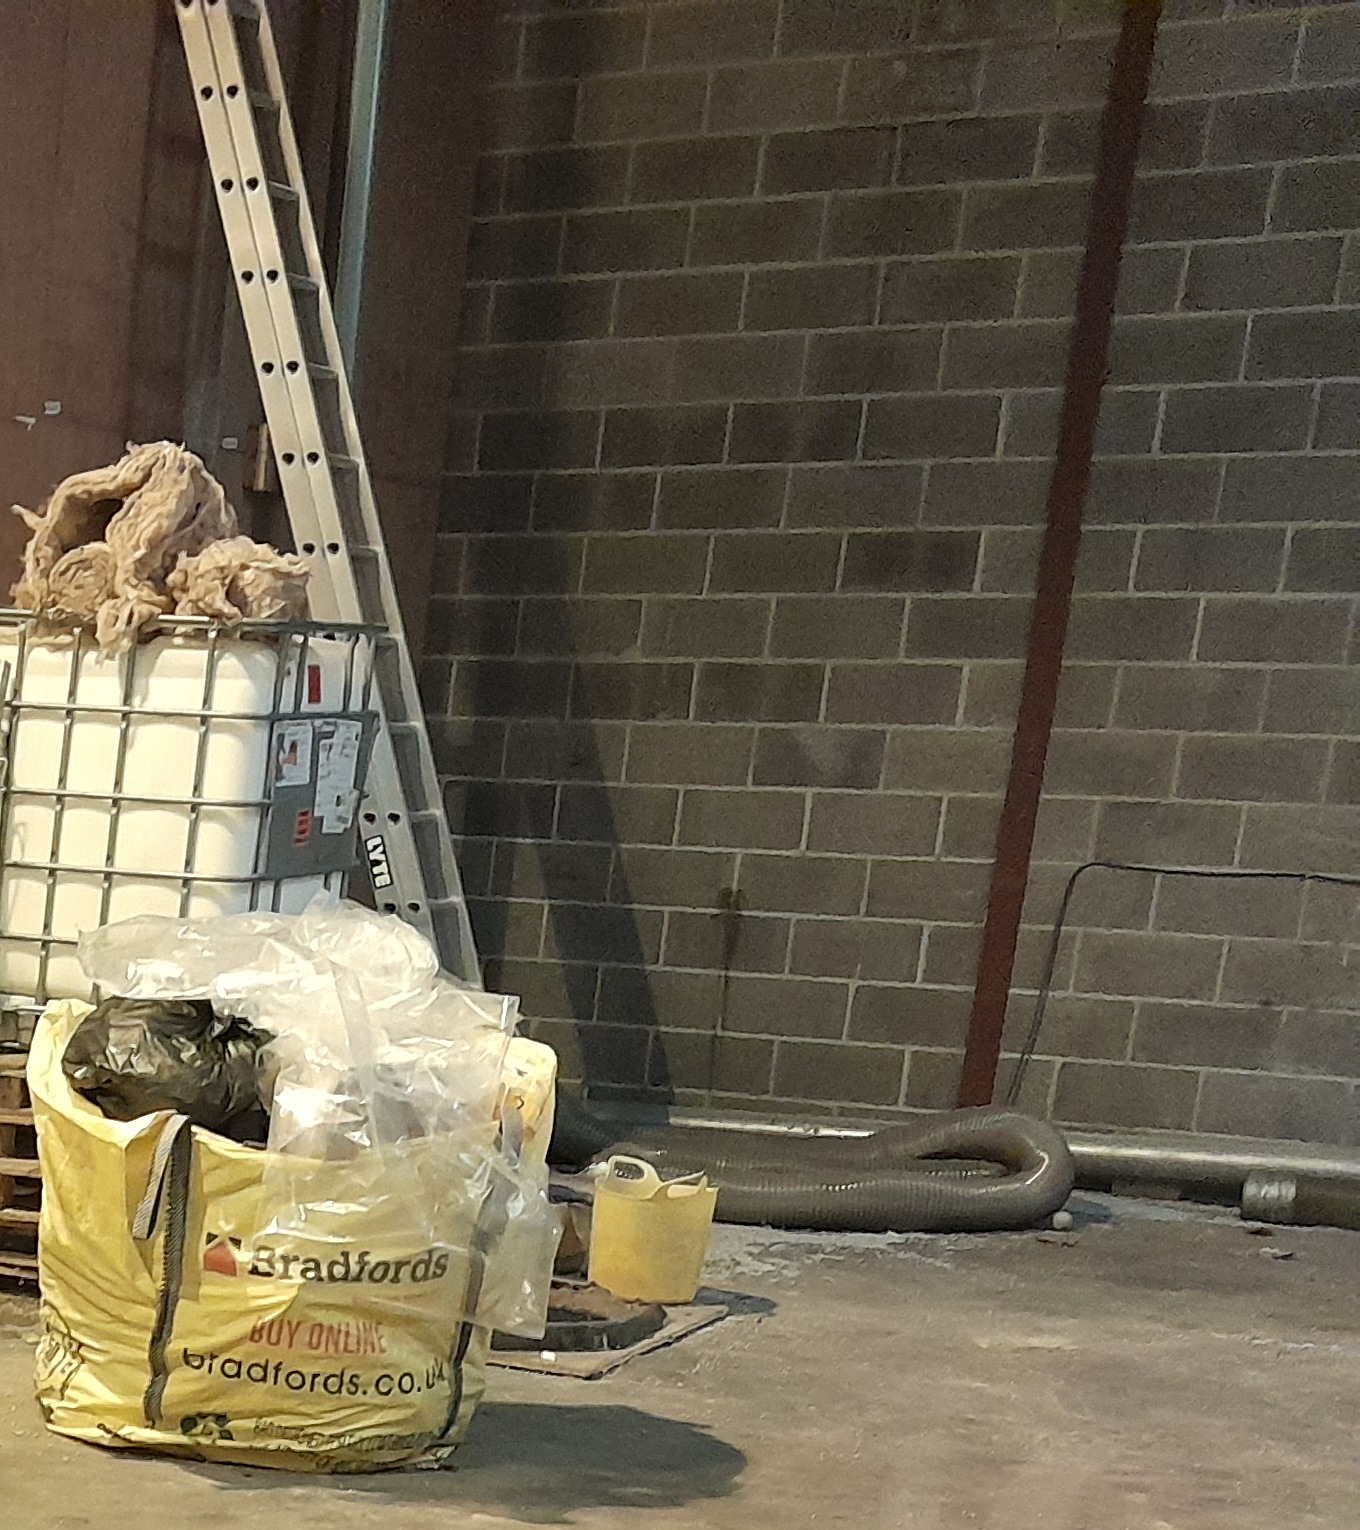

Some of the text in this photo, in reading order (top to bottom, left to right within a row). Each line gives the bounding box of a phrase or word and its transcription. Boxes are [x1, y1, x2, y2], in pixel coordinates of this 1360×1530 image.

[365, 836, 392, 888] LYTE
[248, 1244, 450, 1284] Bradfords
[249, 1316, 388, 1355] BUY ONLINE
[182, 1347, 447, 1397] bradfords.co.uk
